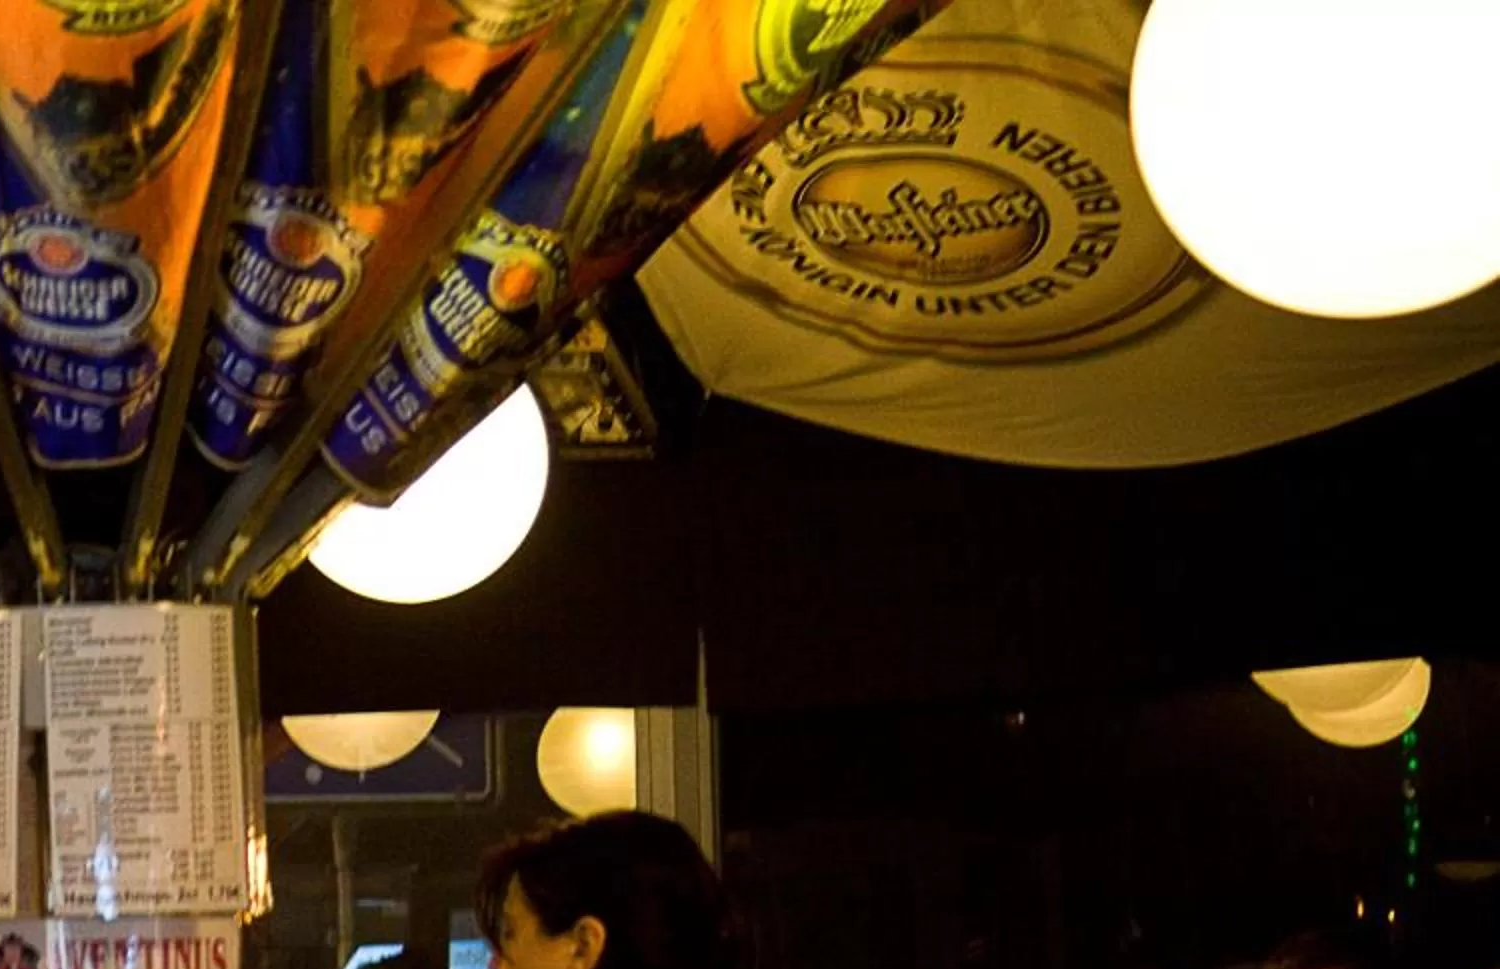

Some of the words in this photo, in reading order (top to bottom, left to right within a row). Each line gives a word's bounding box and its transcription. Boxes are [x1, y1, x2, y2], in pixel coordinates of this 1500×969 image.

[992, 121, 1121, 215] BIEREN
[1055, 222, 1121, 279] DEN
[914, 275, 1073, 315] UNTER
[32, 397, 105, 434] AUS
